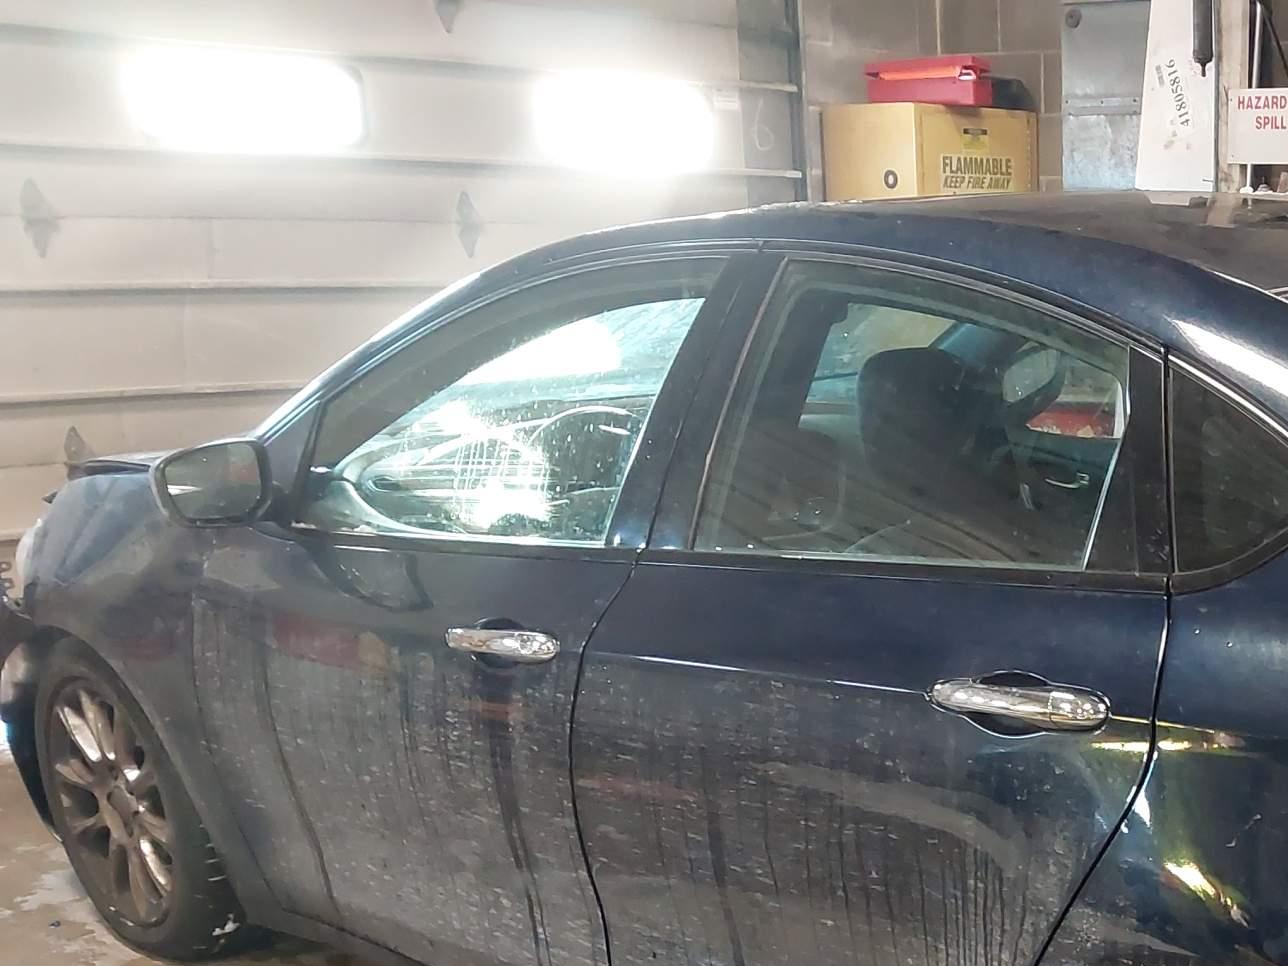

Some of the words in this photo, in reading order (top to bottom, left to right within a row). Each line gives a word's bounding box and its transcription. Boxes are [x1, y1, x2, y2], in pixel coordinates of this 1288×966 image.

[1165, 59, 1191, 127] 41805816
[1255, 115, 1287, 130] SPILL
[942, 155, 1013, 177] FLAMMABLE
[943, 175, 966, 189] KEEP
[966, 176, 987, 190] FIRE
[987, 177, 1012, 190] AWAY
